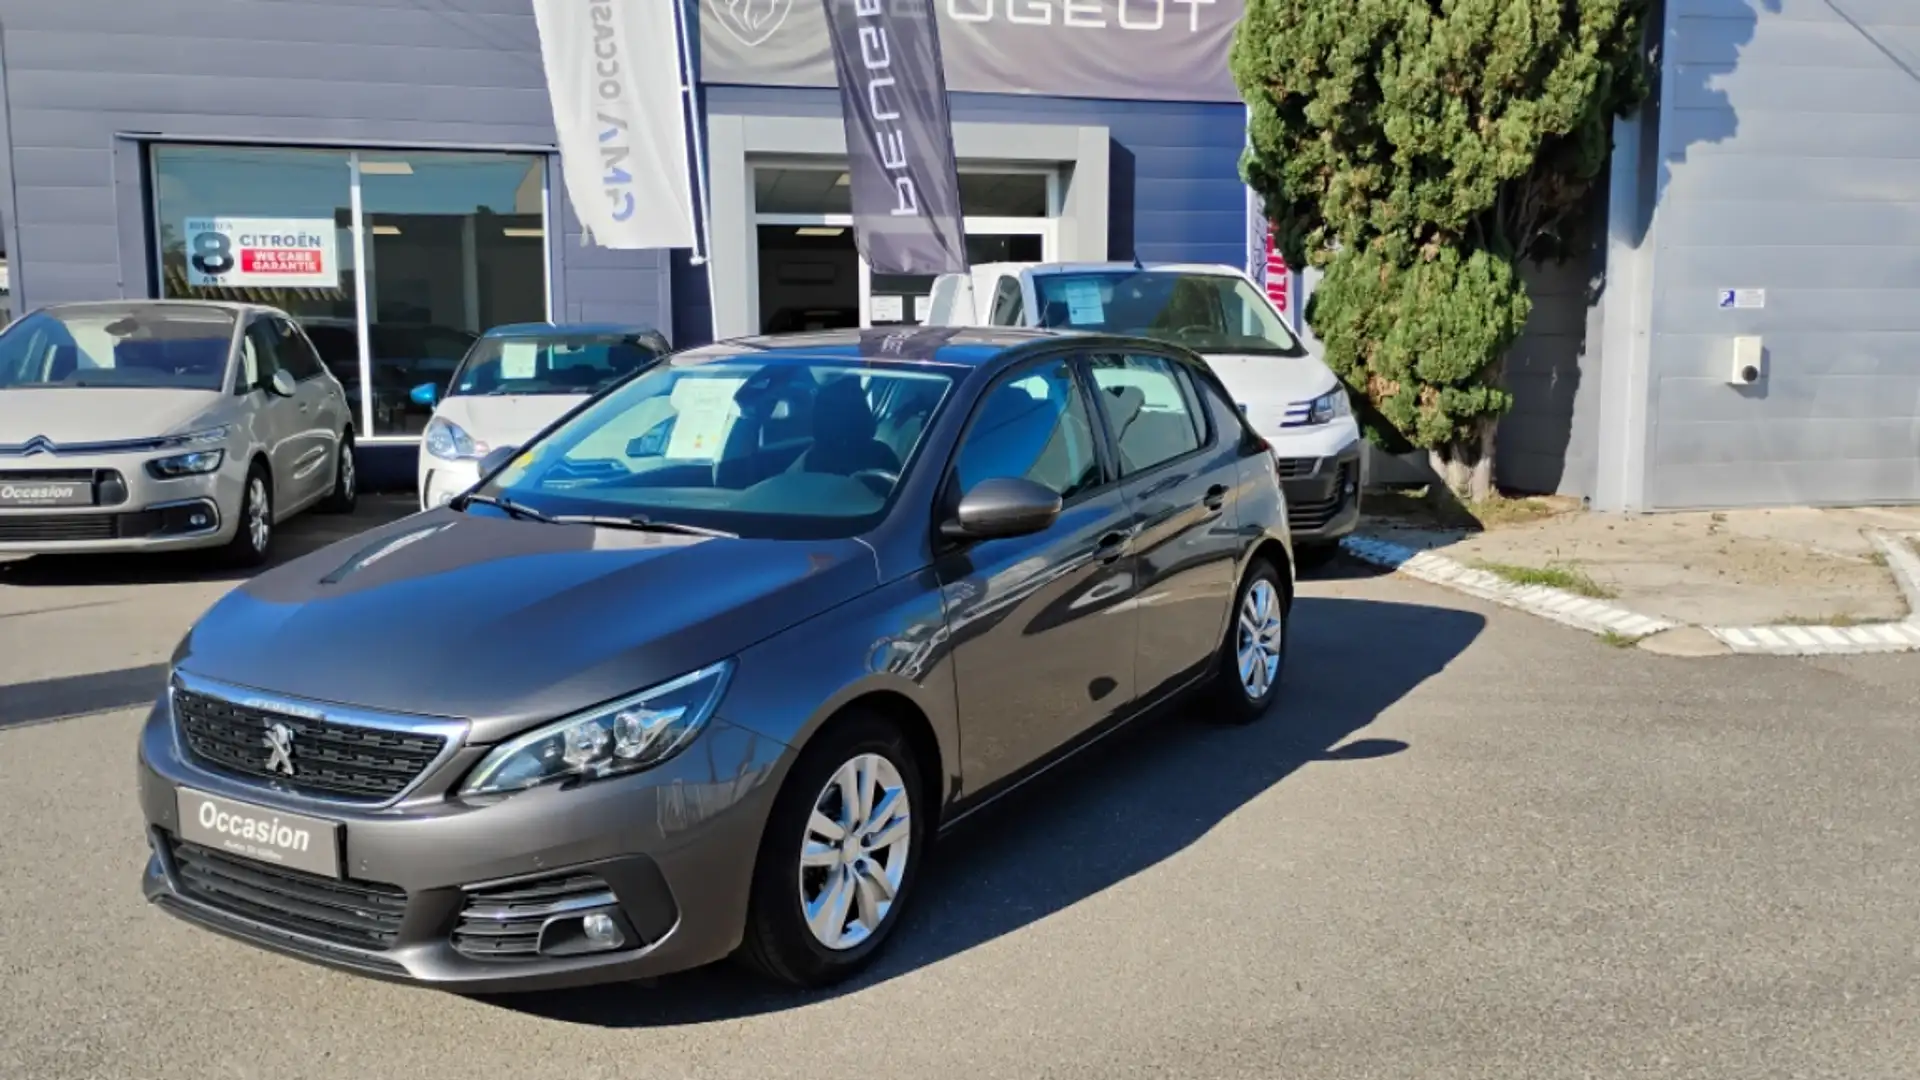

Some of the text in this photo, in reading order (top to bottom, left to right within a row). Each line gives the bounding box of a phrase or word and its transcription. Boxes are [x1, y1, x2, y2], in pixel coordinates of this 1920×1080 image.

[239, 231, 321, 247] CITROËN
[192, 231, 234, 275] 8
[254, 251, 276, 261] WE
[1, 485, 74, 499] Occasion
[199, 800, 310, 852] Occasion
